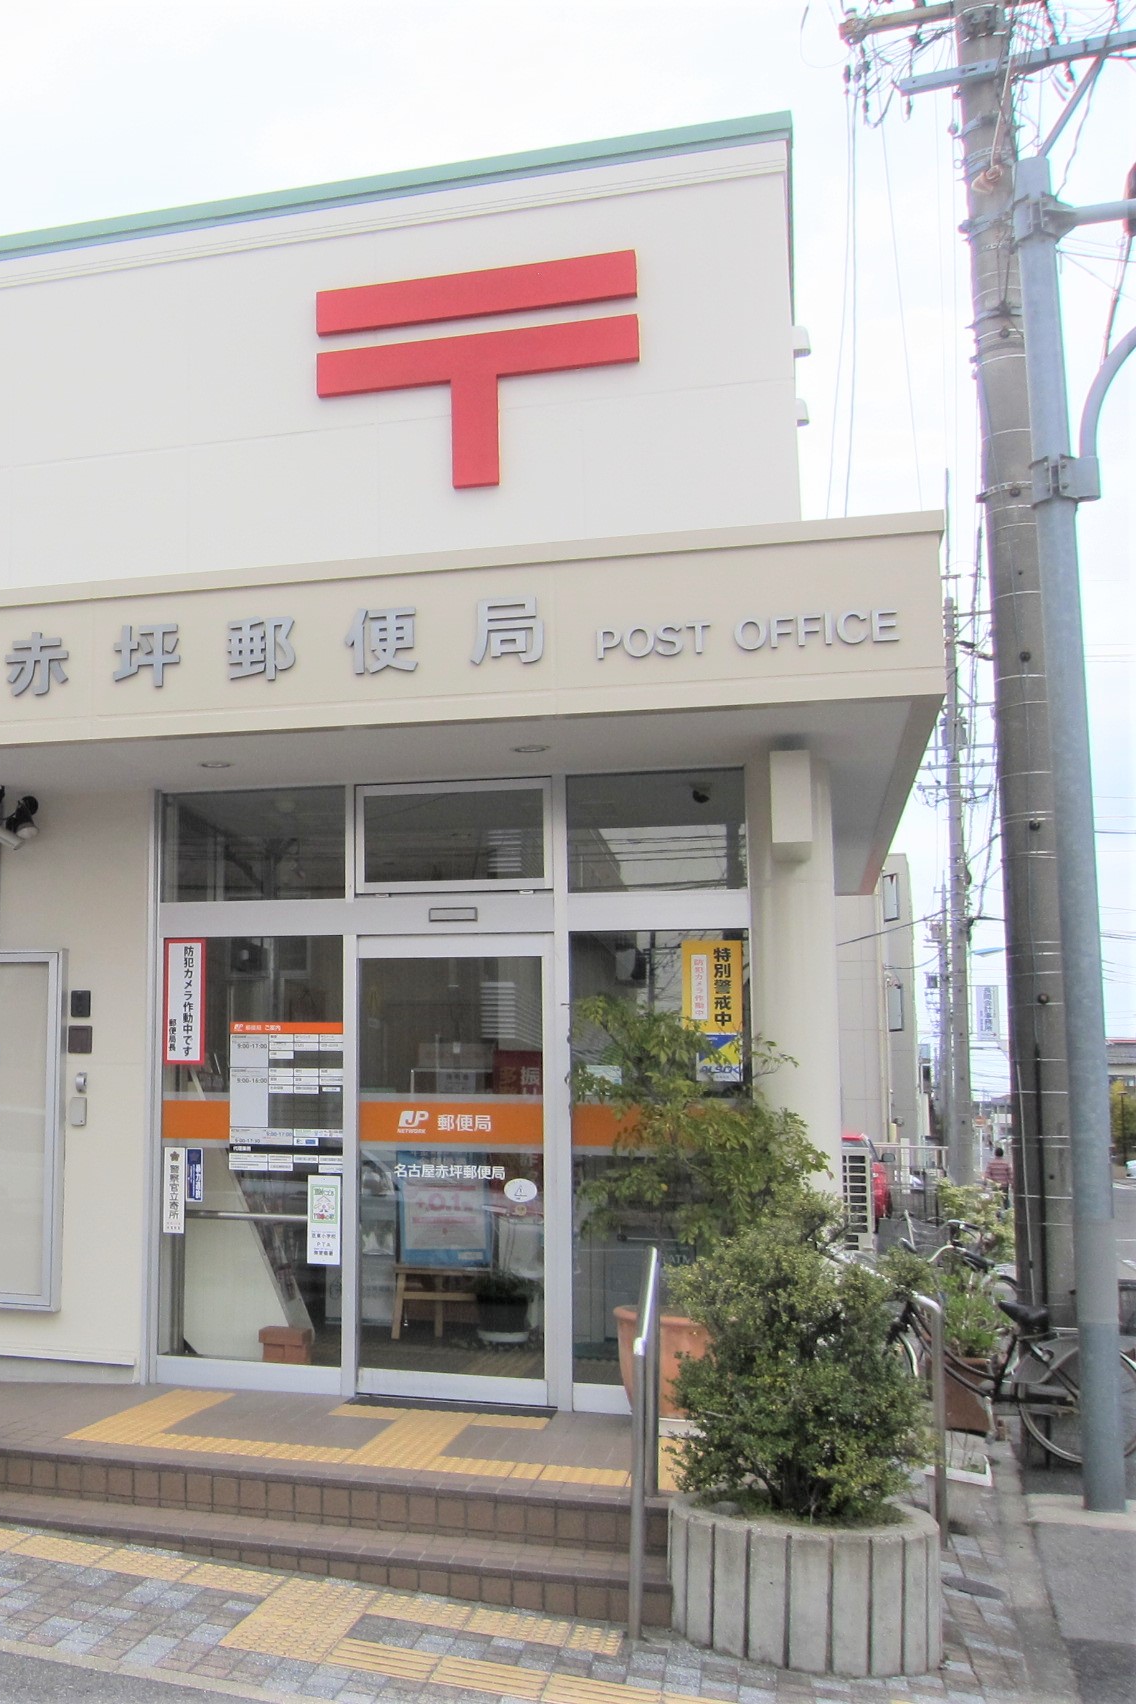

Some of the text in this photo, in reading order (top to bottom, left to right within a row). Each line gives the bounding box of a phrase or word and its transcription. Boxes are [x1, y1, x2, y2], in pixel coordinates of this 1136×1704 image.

[595, 608, 901, 660] POST OFFICE
[182, 946, 195, 1057] 防犯カメラ作動中です
[693, 958, 705, 1016] 防犯カメラ作動中
[713, 947, 732, 1027] 特別警戒中
[168, 1018, 177, 1052] 郵便局長
[398, 1110, 429, 1128] JP
[437, 1114, 492, 1132] 郵便局
[169, 1164, 180, 1220] 警察官立寄所
[393, 1163, 506, 1181] 名古屋赤坪郵便局
